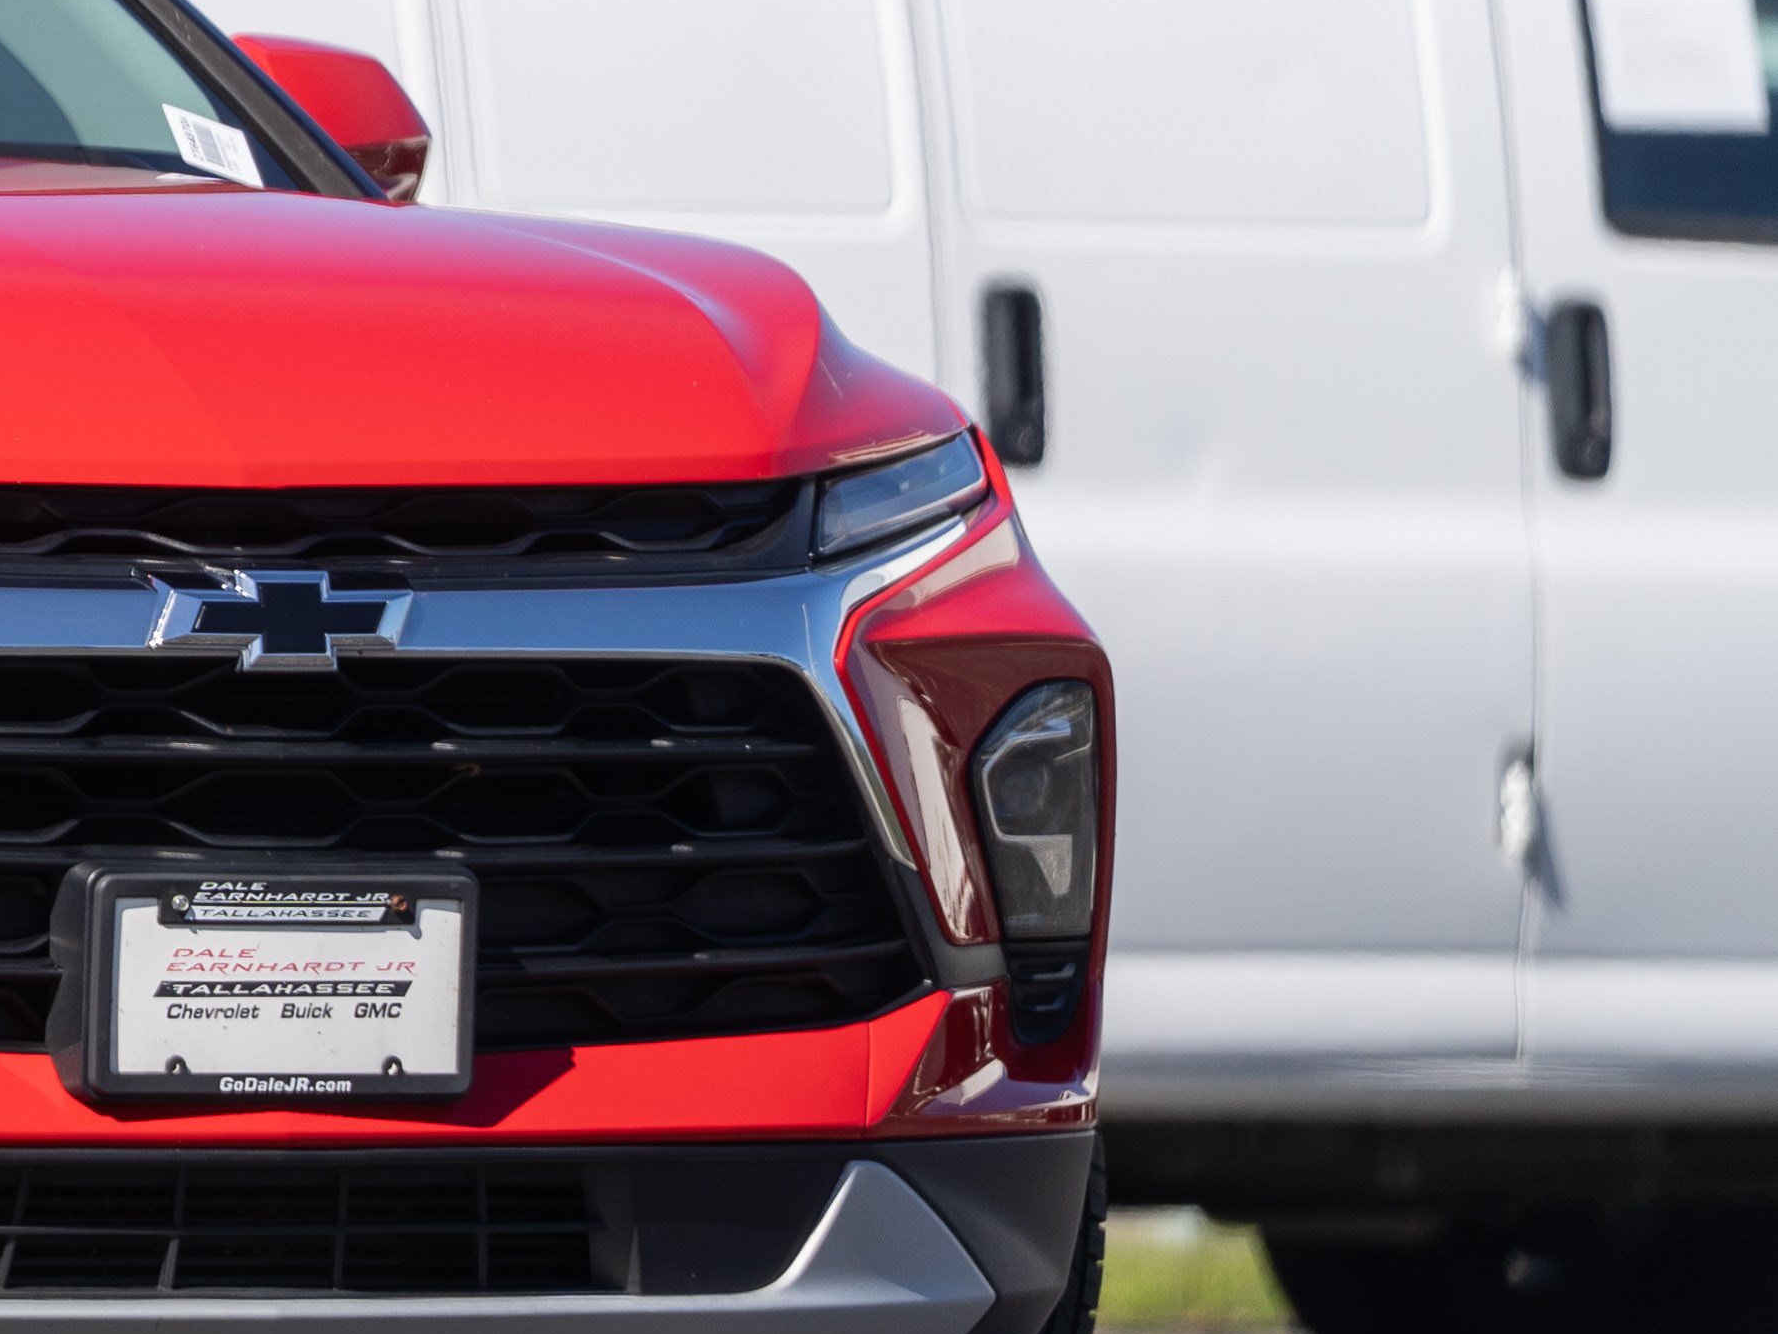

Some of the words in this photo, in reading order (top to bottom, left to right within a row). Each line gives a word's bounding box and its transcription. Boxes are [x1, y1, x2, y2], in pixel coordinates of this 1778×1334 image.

[199, 881, 268, 891] DALE
[193, 891, 350, 903] EARNHARDT
[199, 908, 372, 919] TALLAHASSEE
[171, 947, 259, 959] DALE
[165, 961, 366, 975] EARNHARDT
[374, 961, 417, 975] JR
[171, 982, 397, 995] TALLAHASSEE
[166, 1003, 260, 1019] Chevrolet
[280, 1003, 333, 1019] Buick
[353, 1003, 403, 1019] GMC
[219, 1076, 352, 1093] GoDaleJR.com
